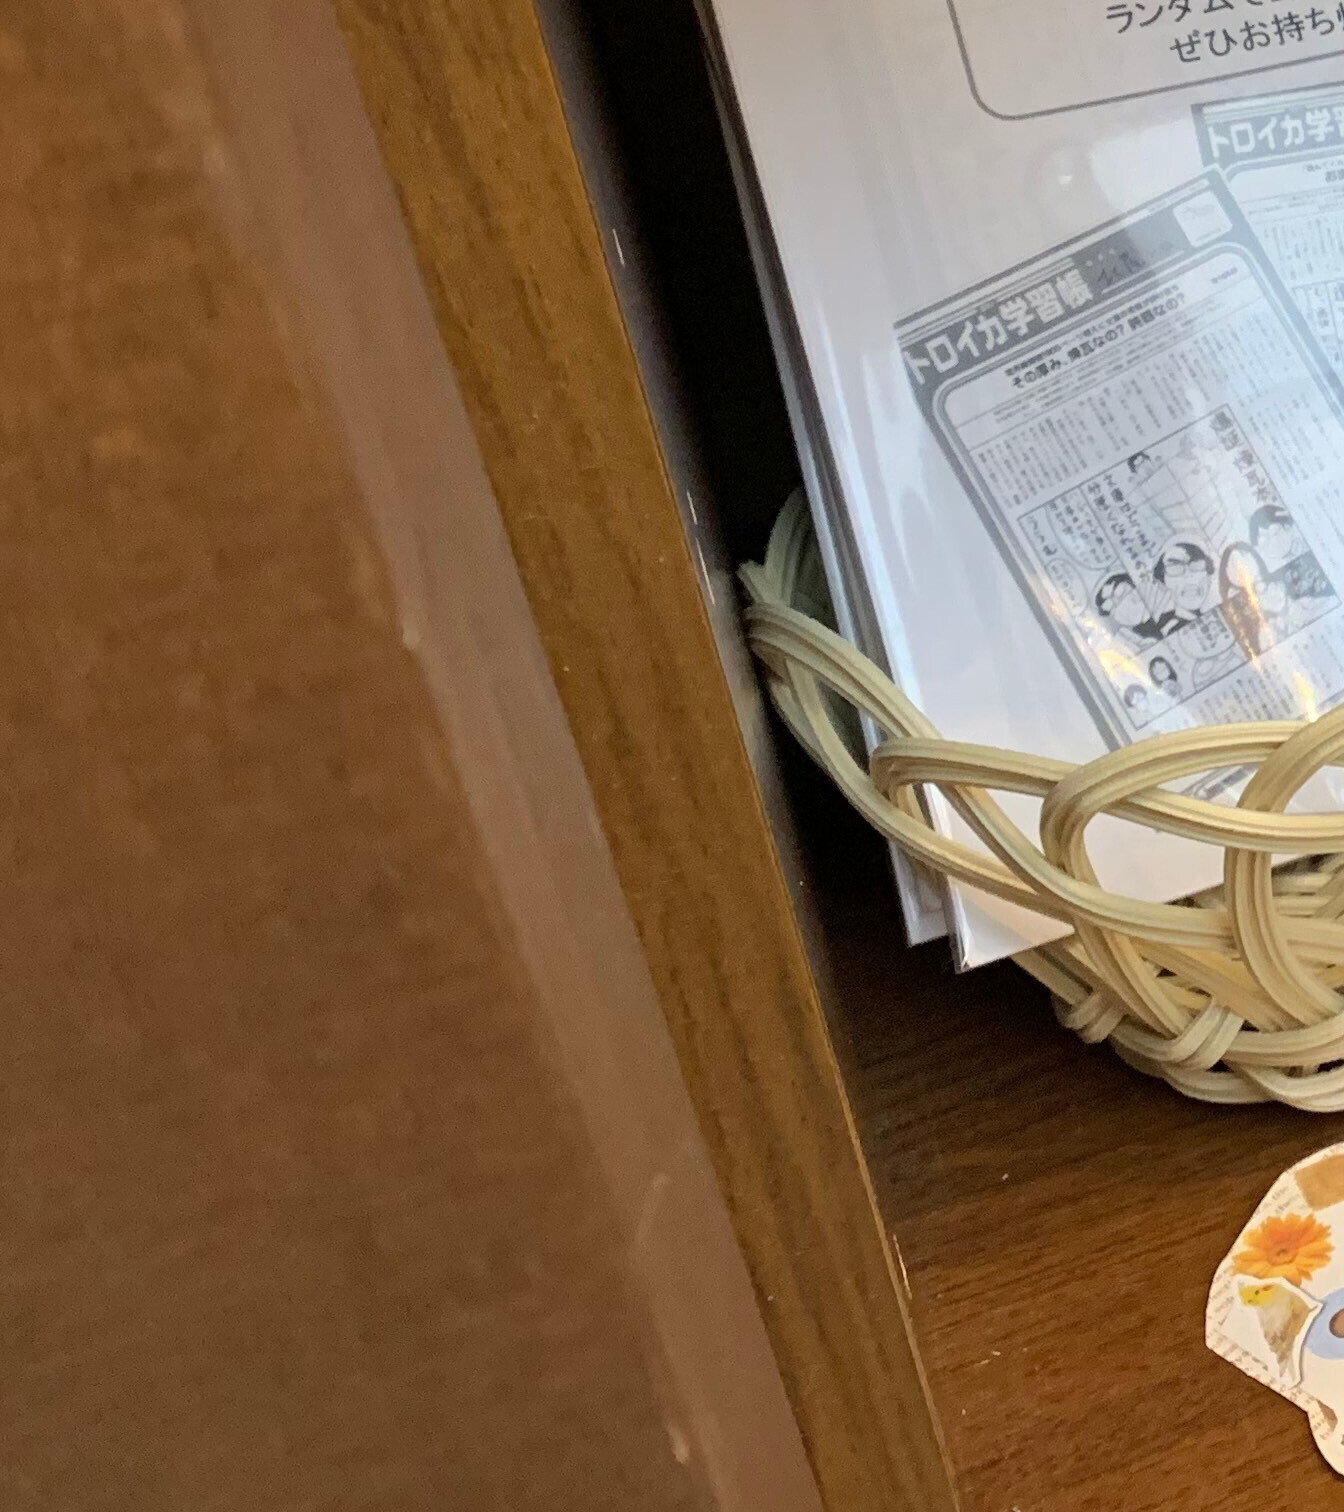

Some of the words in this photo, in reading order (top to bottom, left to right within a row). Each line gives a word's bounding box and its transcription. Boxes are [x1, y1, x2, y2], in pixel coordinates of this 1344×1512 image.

[904, 269, 1093, 384] トロイカ学習帳
